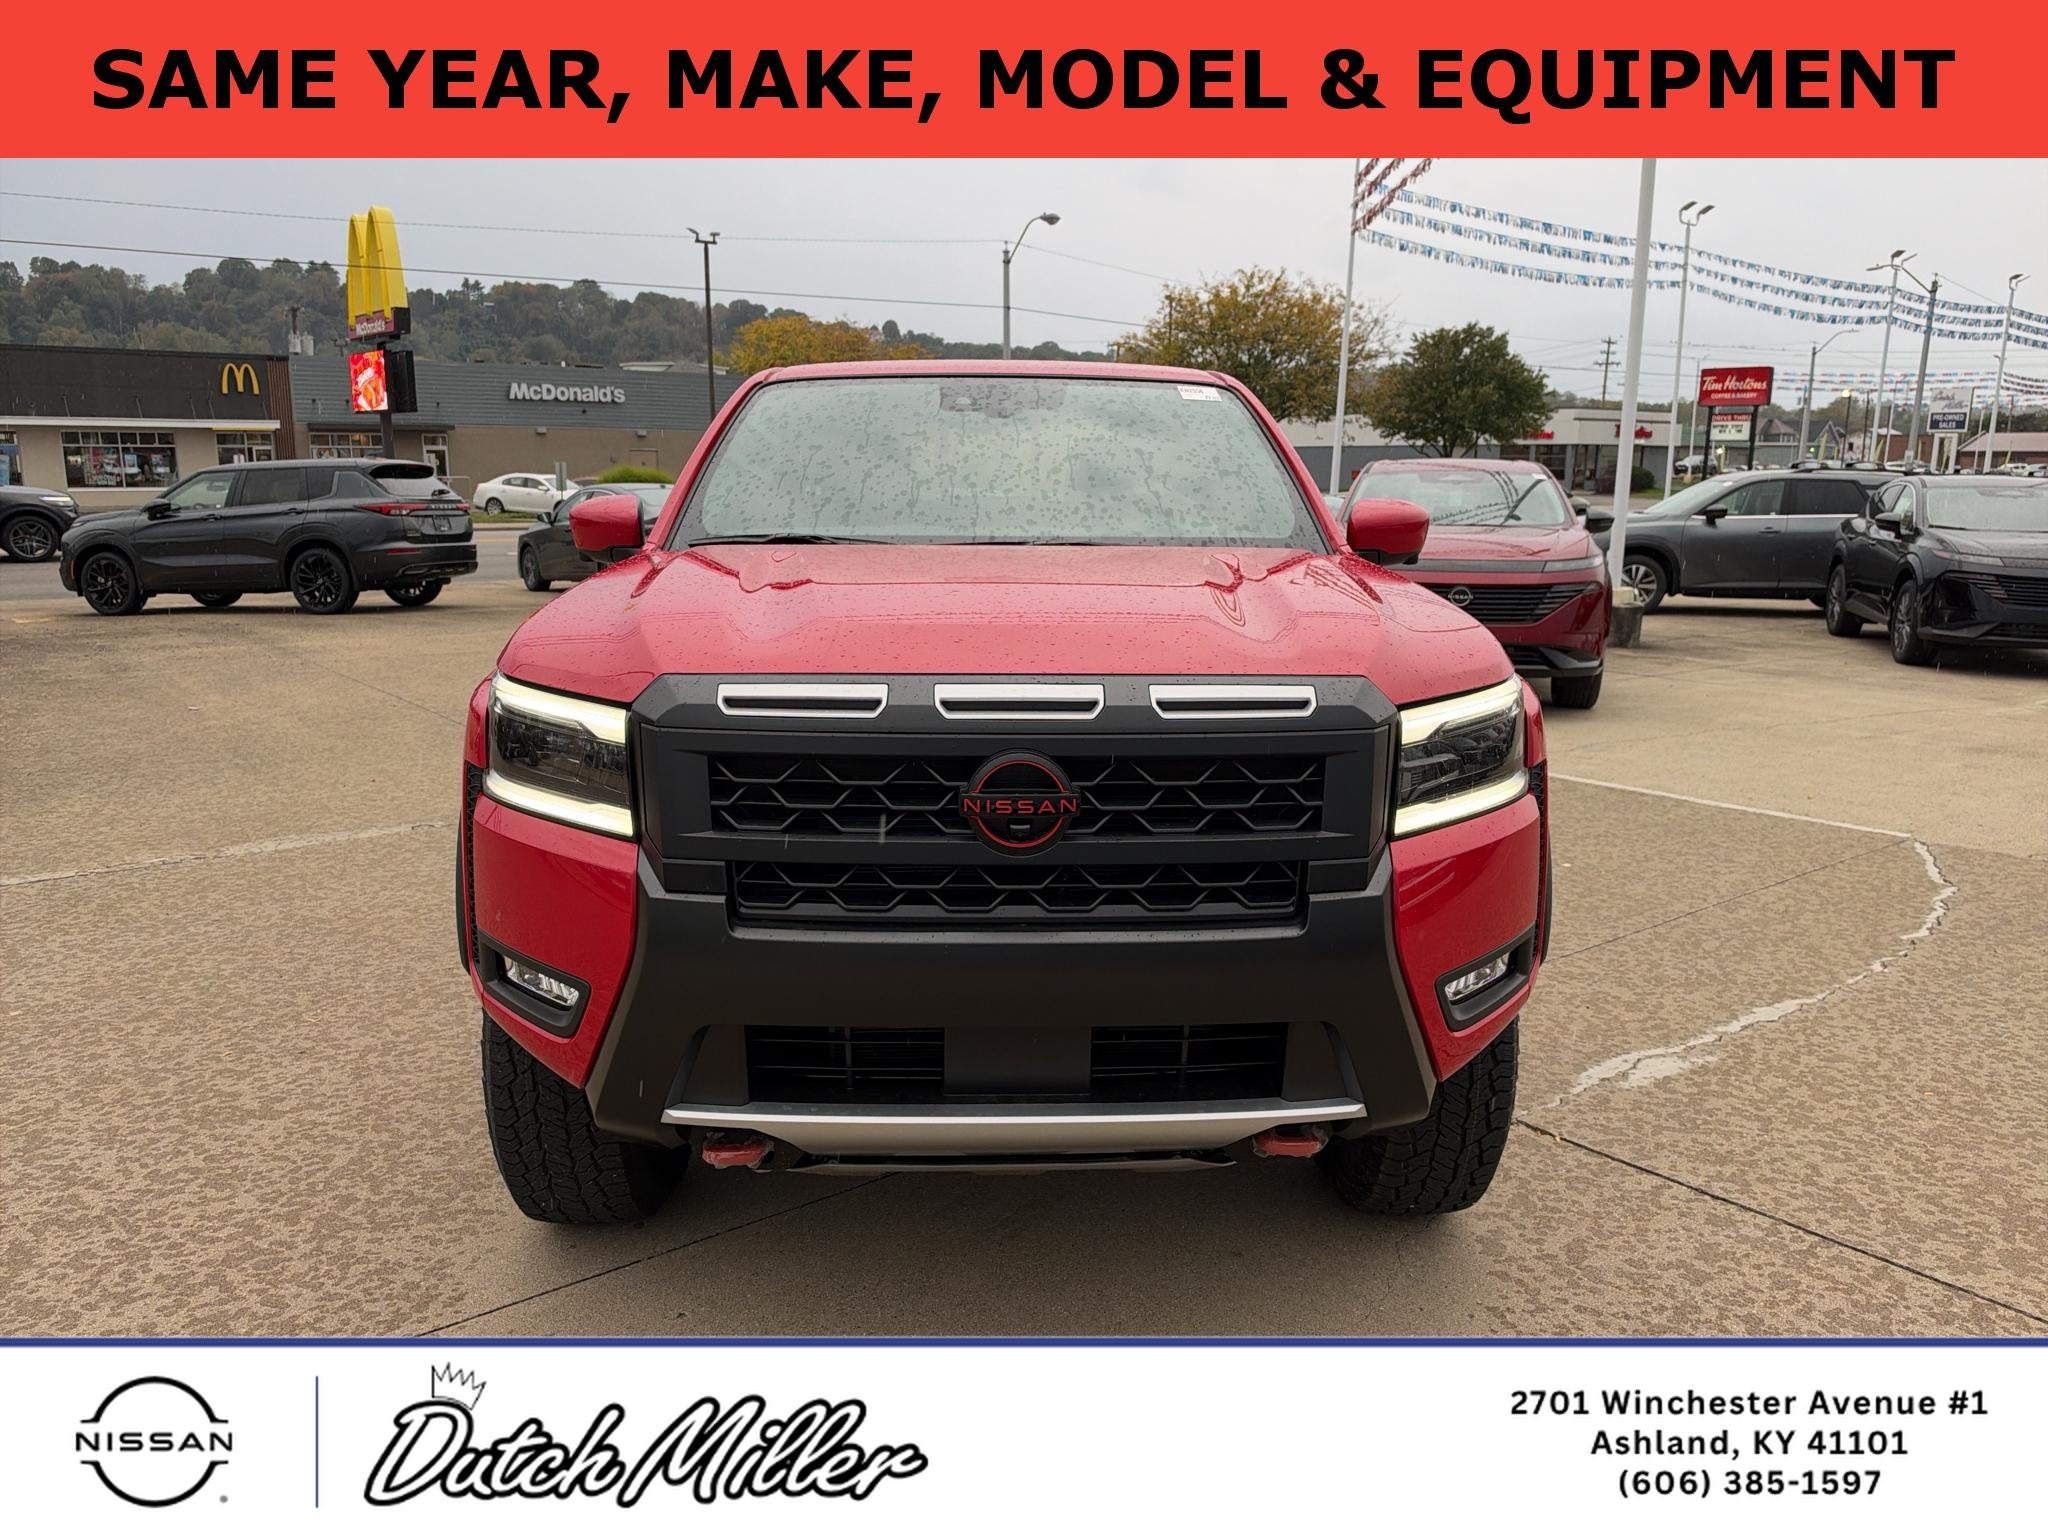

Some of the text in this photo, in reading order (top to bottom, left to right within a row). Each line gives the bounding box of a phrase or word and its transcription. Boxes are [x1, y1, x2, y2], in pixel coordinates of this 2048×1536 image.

[1702, 374, 1767, 391] Tim Hortons
[509, 382, 626, 403] McDonald's
[962, 798, 1078, 814] NISSAN
